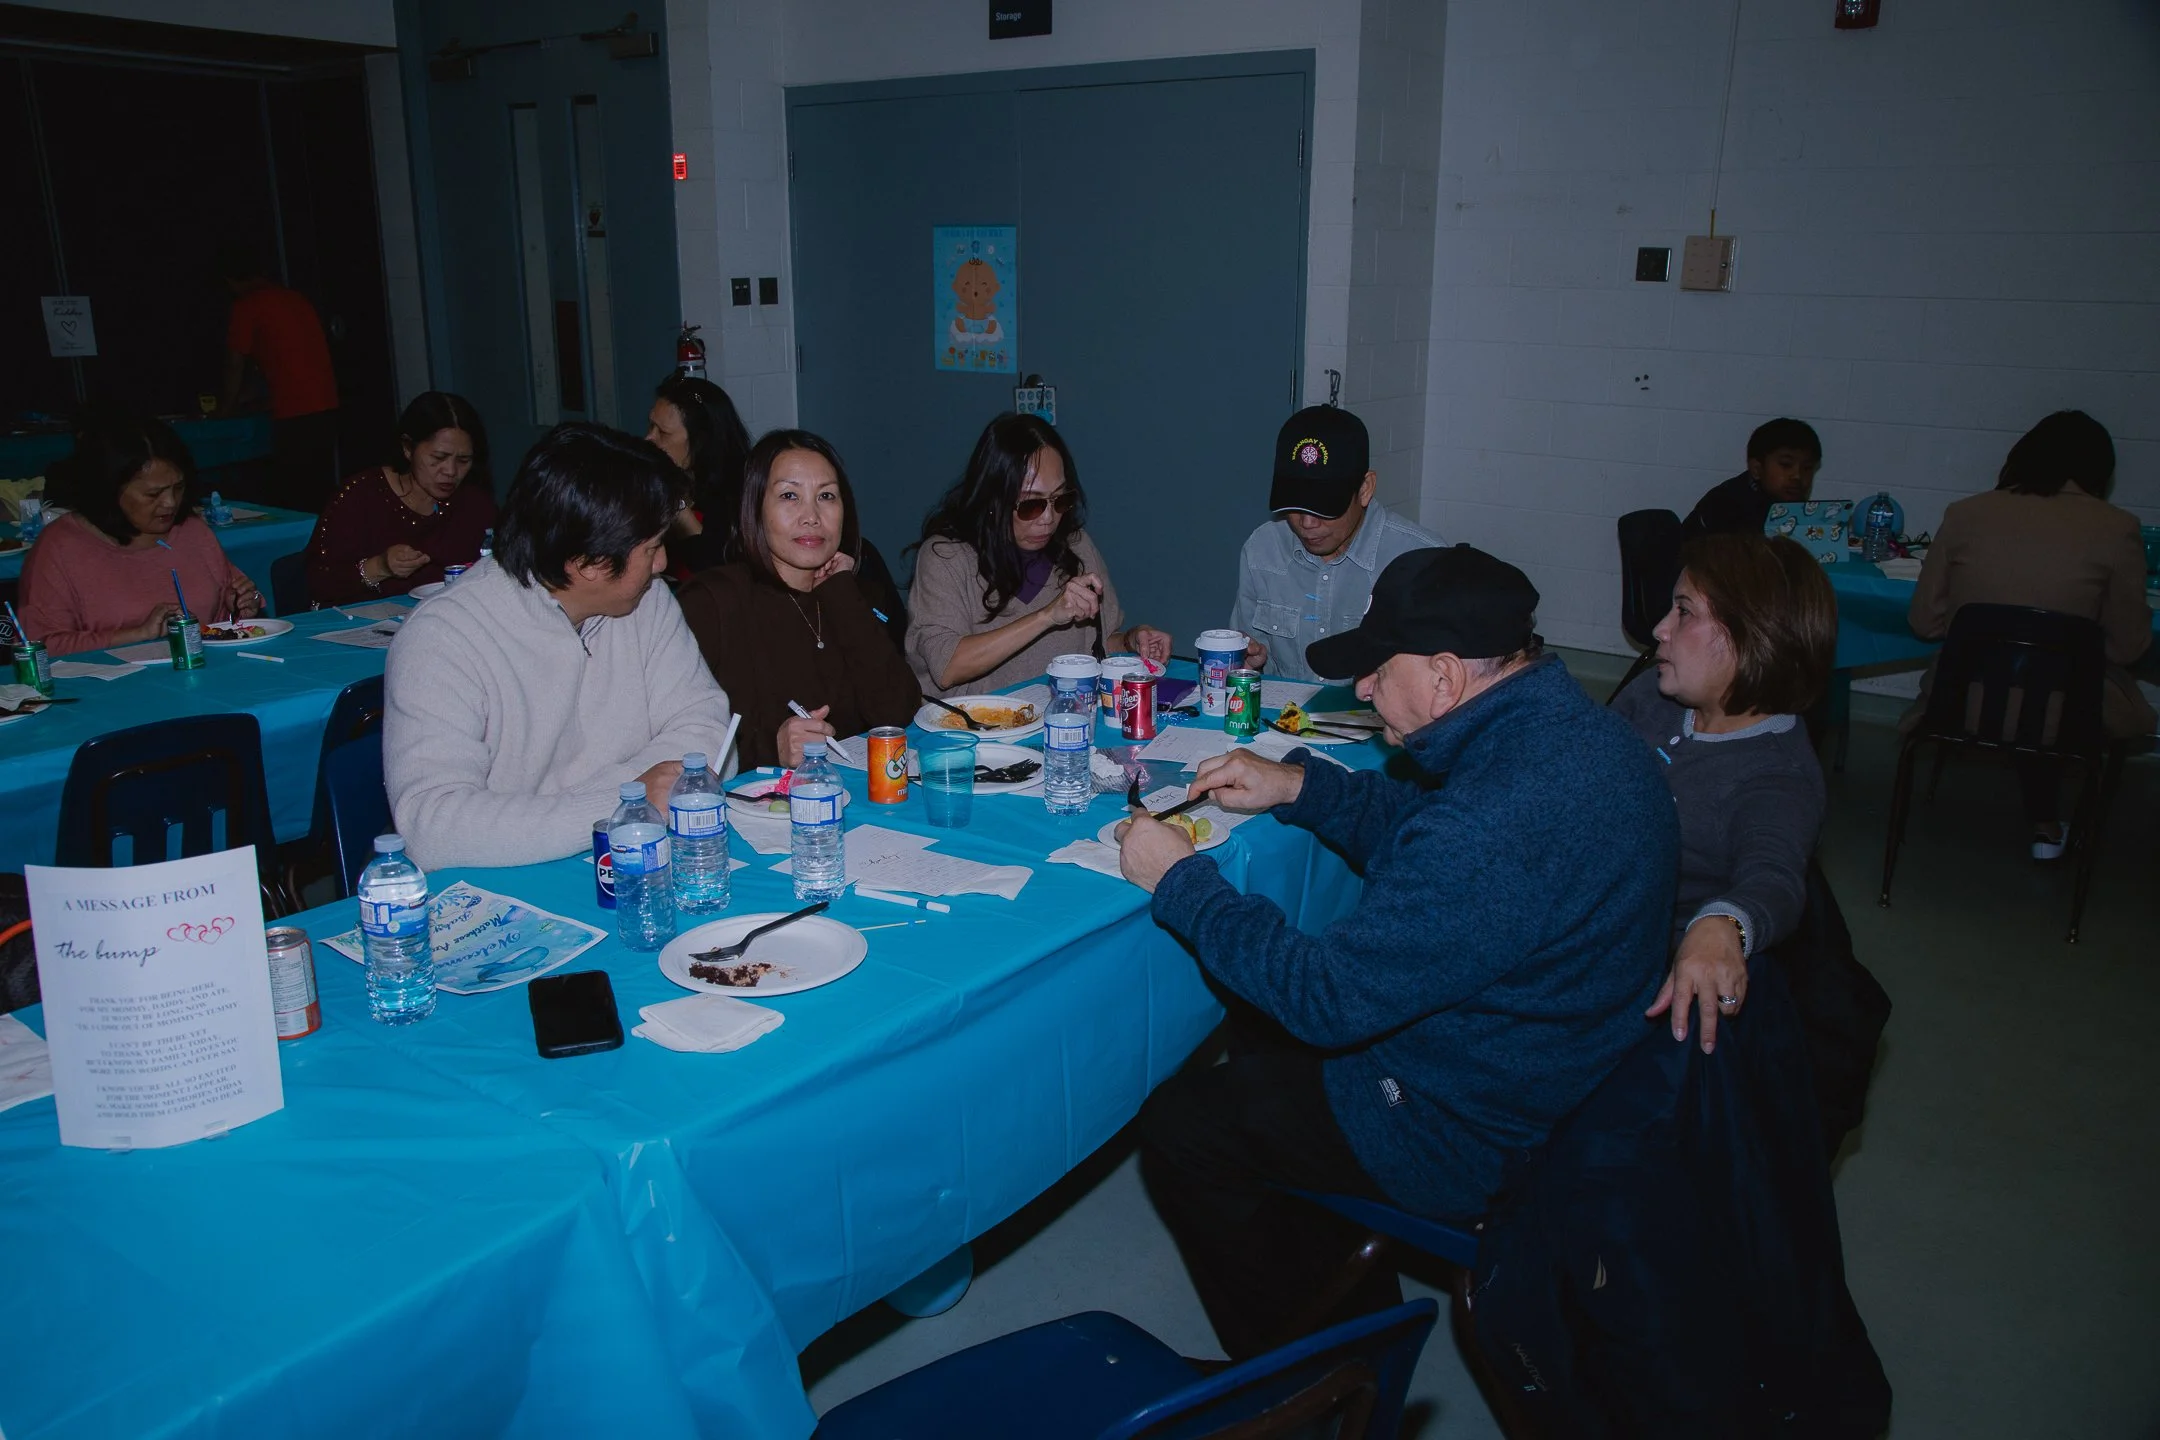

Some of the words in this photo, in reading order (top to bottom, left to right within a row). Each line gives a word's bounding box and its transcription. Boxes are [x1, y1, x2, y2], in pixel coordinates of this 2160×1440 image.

[995, 11, 1022, 22] Storage
[1225, 687, 1237, 715] 7
[1229, 700, 1244, 712] up
[1229, 720, 1250, 730] mini
[62, 899, 73, 911] A
[76, 894, 158, 912] MESSAGE
[162, 883, 216, 905] FROM
[54, 940, 89, 960] the
[95, 939, 161, 968] bump
[89, 996, 117, 1004] THANK
[118, 996, 134, 1004] YOU
[138, 993, 158, 1003] FOR
[160, 988, 190, 1000] BEING
[191, 981, 217, 993] HERE
[190, 992, 209, 1002] AND
[156, 1009, 184, 1019] LONG
[186, 1002, 207, 1011] NOW
[157, 1012, 204, 1027] MOMMY'S
[142, 1040, 152, 1048] BE
[156, 1034, 186, 1046] THERE
[189, 1028, 207, 1038] YET
[144, 1047, 162, 1056] YOU
[167, 1043, 184, 1052] ALL
[151, 1052, 187, 1065] FAMILY
[190, 1043, 220, 1057] LOVES
[220, 1036, 239, 1047] YOU
[138, 1065, 173, 1075] WORDS
[173, 1059, 193, 1069] CAN
[195, 1052, 220, 1064] EVER
[165, 1079, 182, 1089] ALL
[184, 1075, 197, 1083] SO
[198, 1063, 237, 1081] EXCITED
[142, 1087, 185, 1100] MOMENT
[194, 1075, 228, 1090] APPEAR
[135, 1101, 158, 1109] SOME
[161, 1090, 213, 1106] MEMORIES
[140, 1109, 166, 1118] THEM
[166, 1102, 197, 1115] CLOSE
[201, 1096, 220, 1106] AND
